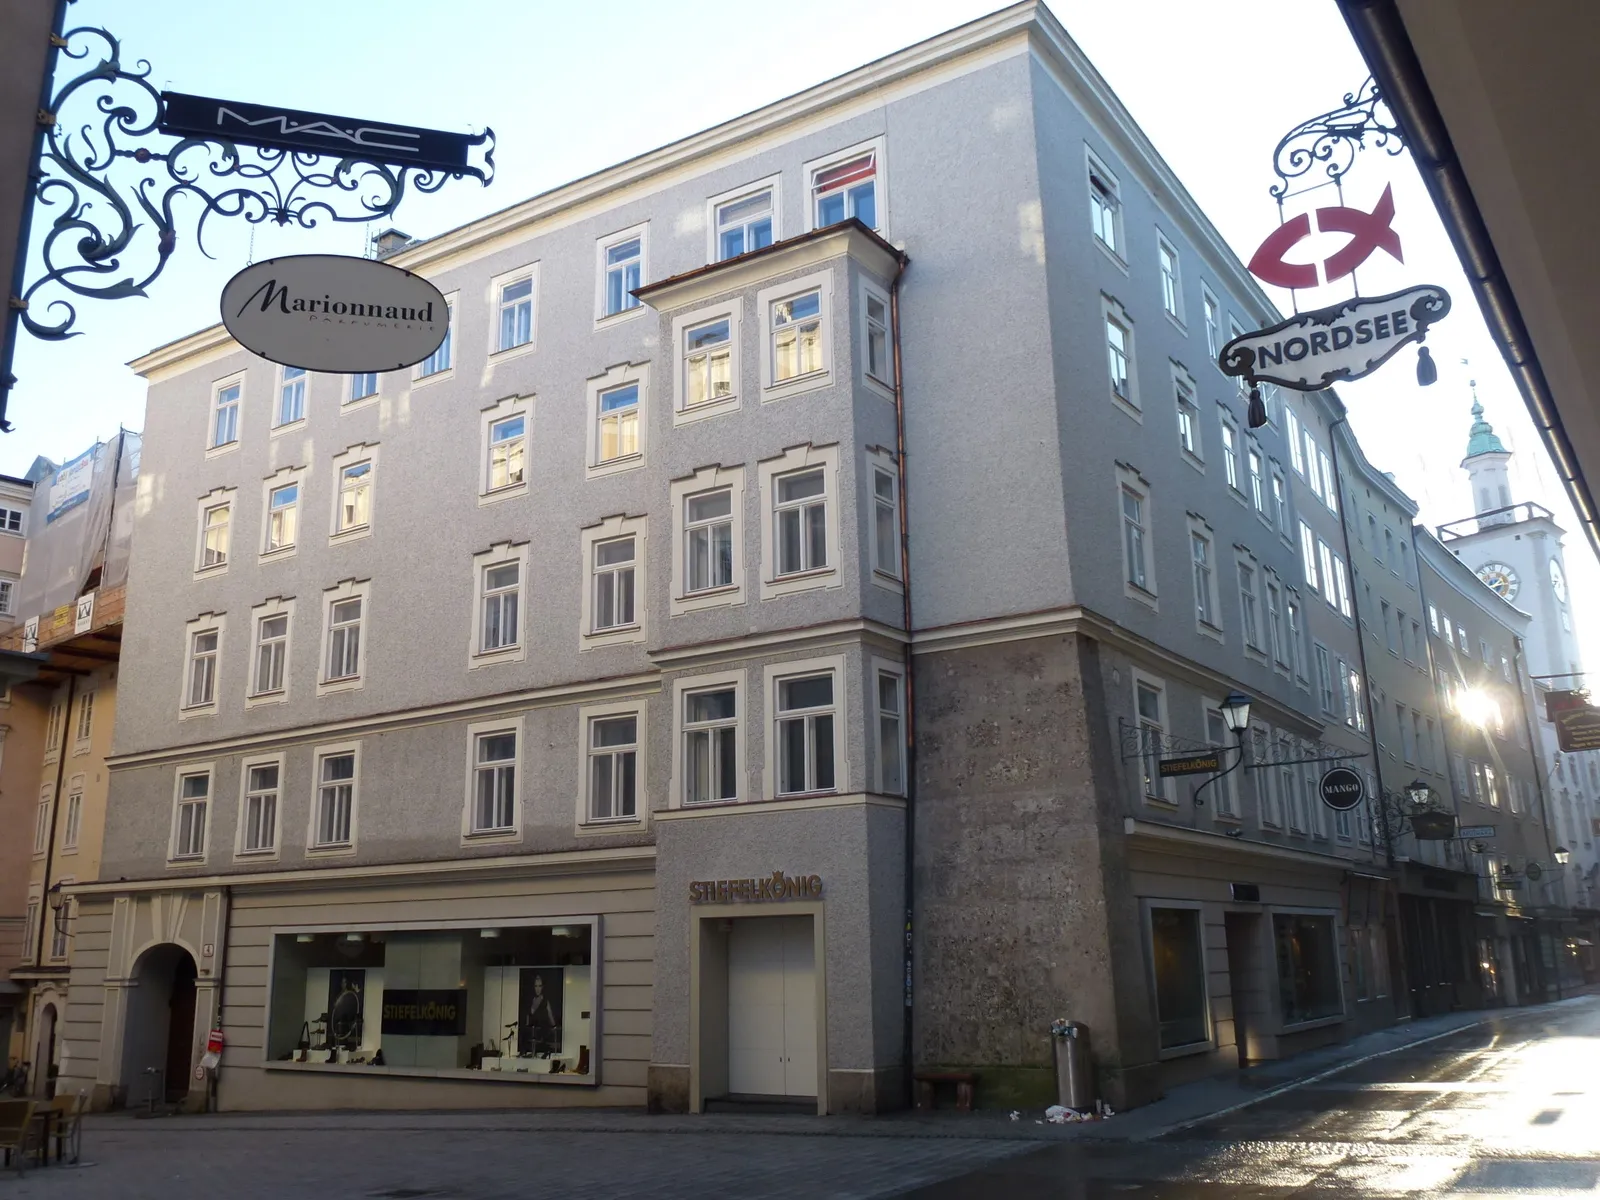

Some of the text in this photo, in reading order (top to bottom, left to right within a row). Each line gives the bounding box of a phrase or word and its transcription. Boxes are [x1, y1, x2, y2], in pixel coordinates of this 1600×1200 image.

[237, 279, 433, 322] Marionnaud
[1258, 312, 1409, 369] NORDSEE
[1325, 783, 1359, 794] MANGO
